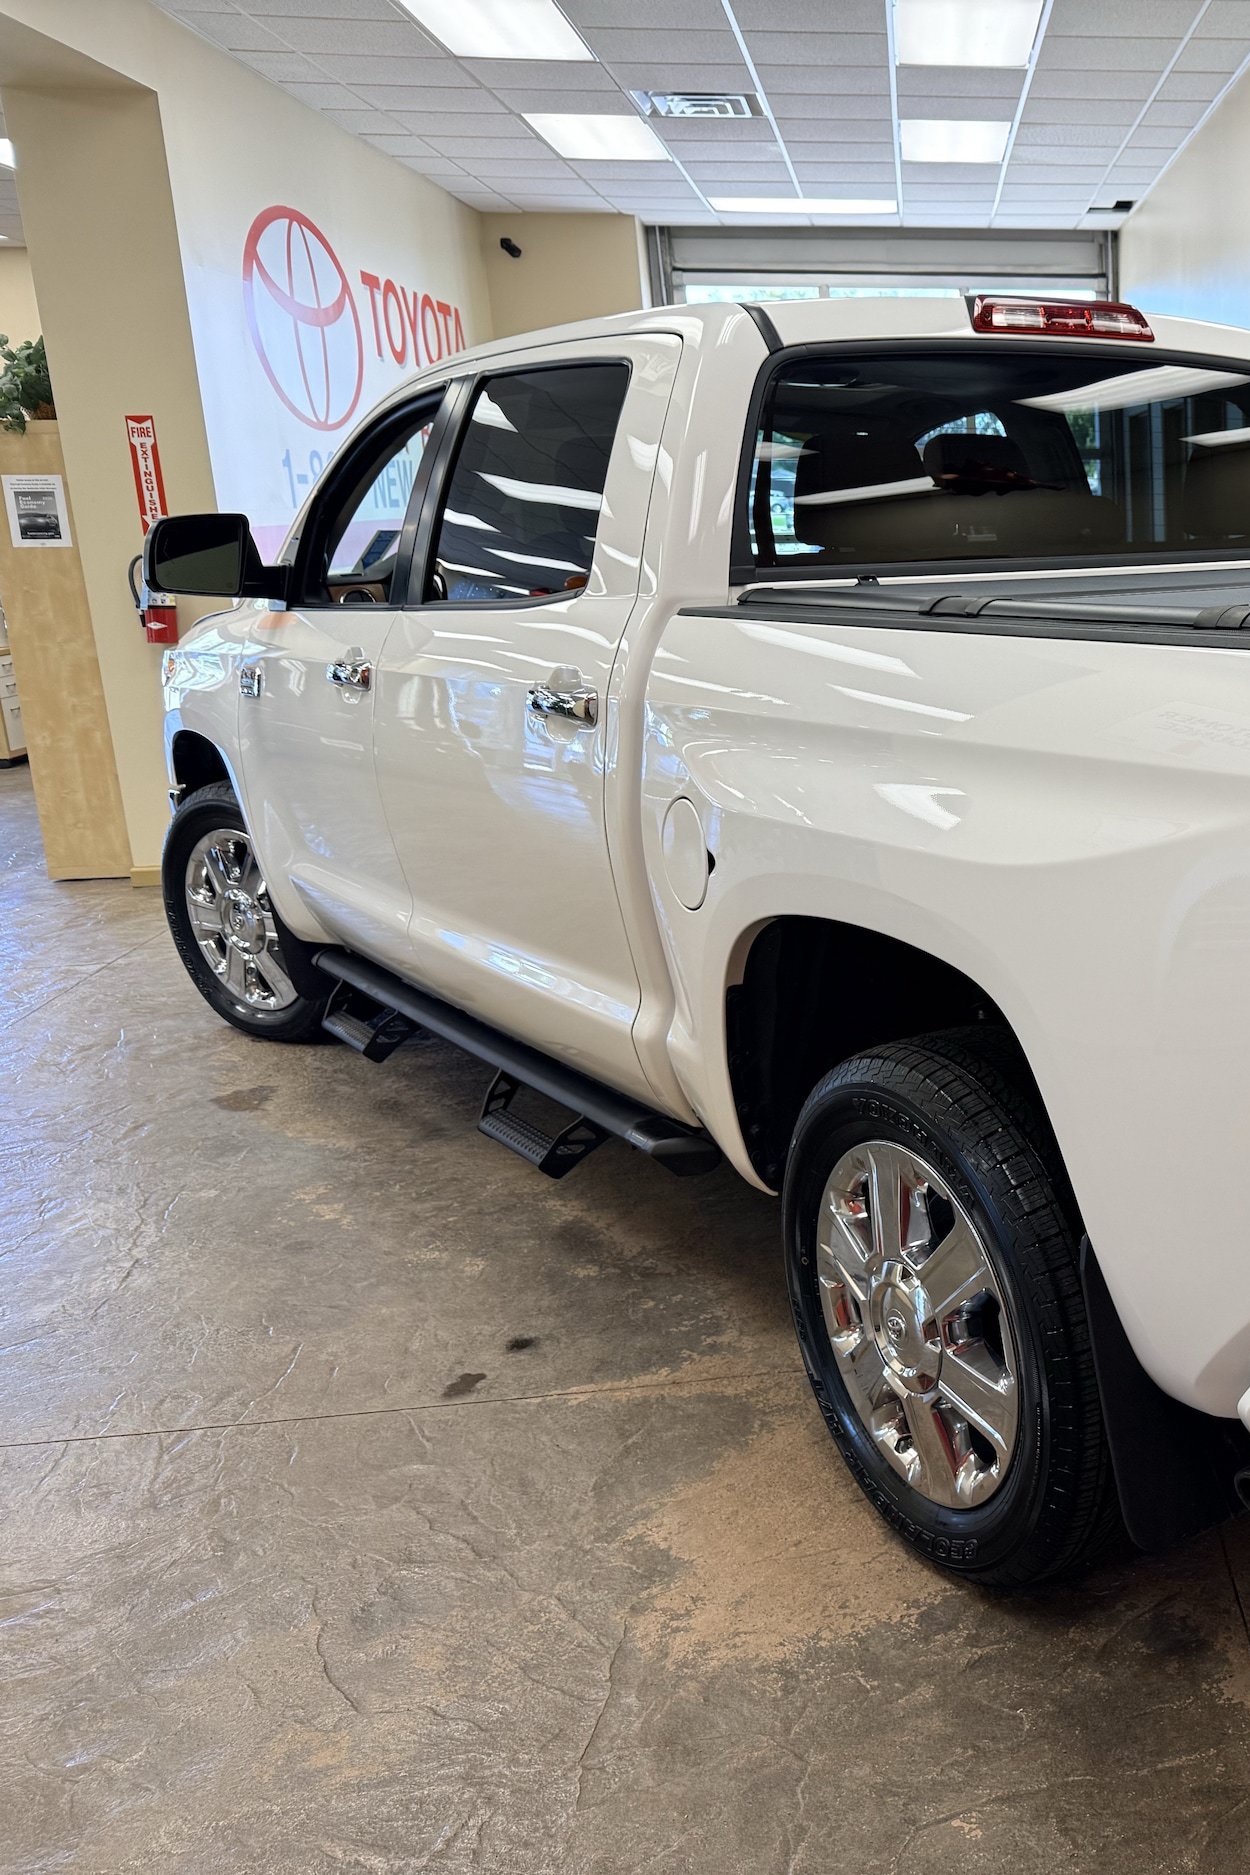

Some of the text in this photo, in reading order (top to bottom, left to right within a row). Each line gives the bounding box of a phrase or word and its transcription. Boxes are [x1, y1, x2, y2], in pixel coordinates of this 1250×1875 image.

[360, 269, 466, 368] TOYOTA
[130, 426, 153, 439] FIRE
[140, 442, 159, 523] EXTINGUISHE
[852, 1097, 976, 1211] YOKOHAMA
